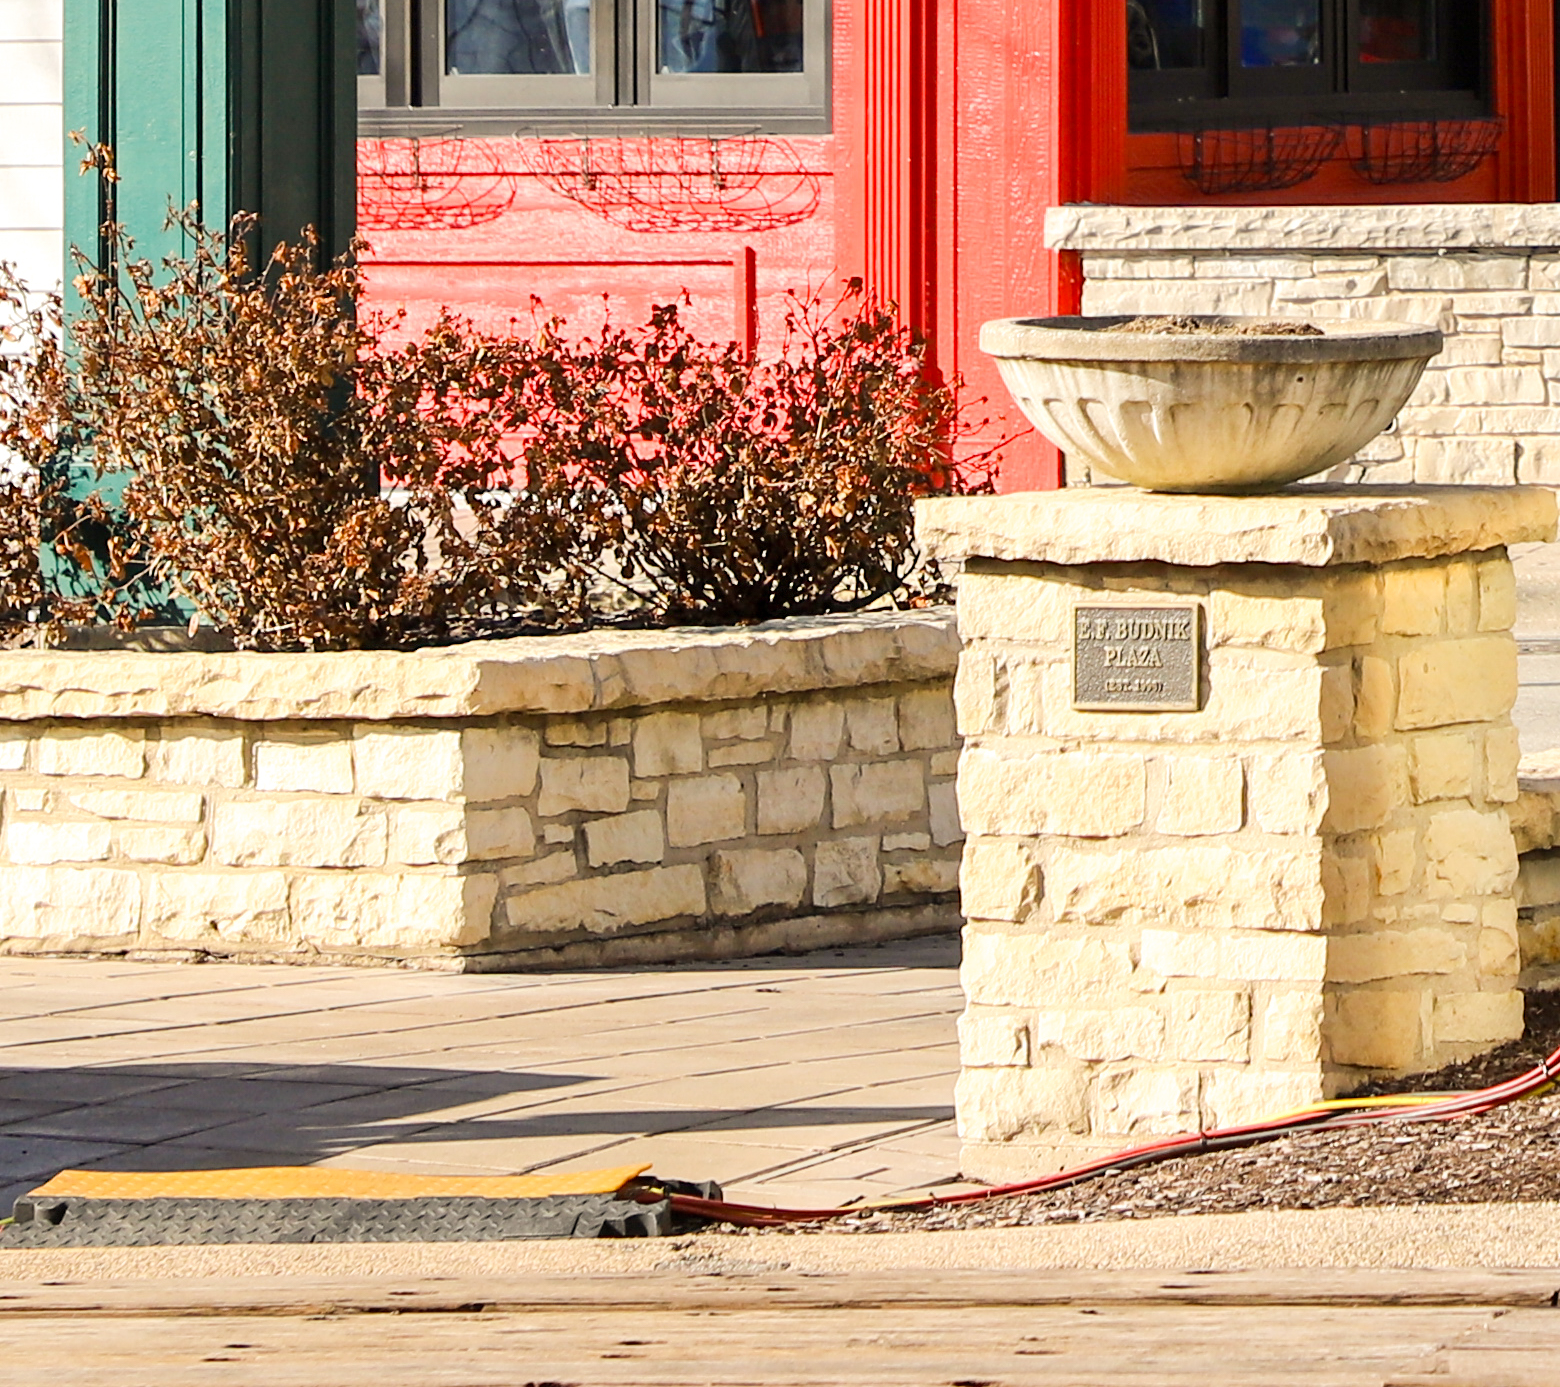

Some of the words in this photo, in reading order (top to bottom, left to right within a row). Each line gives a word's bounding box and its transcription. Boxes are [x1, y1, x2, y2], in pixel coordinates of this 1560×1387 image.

[1078, 617, 1112, 641] E.F.
[1114, 618, 1191, 641] BUDNIK
[1103, 645, 1164, 668] PLAZA
